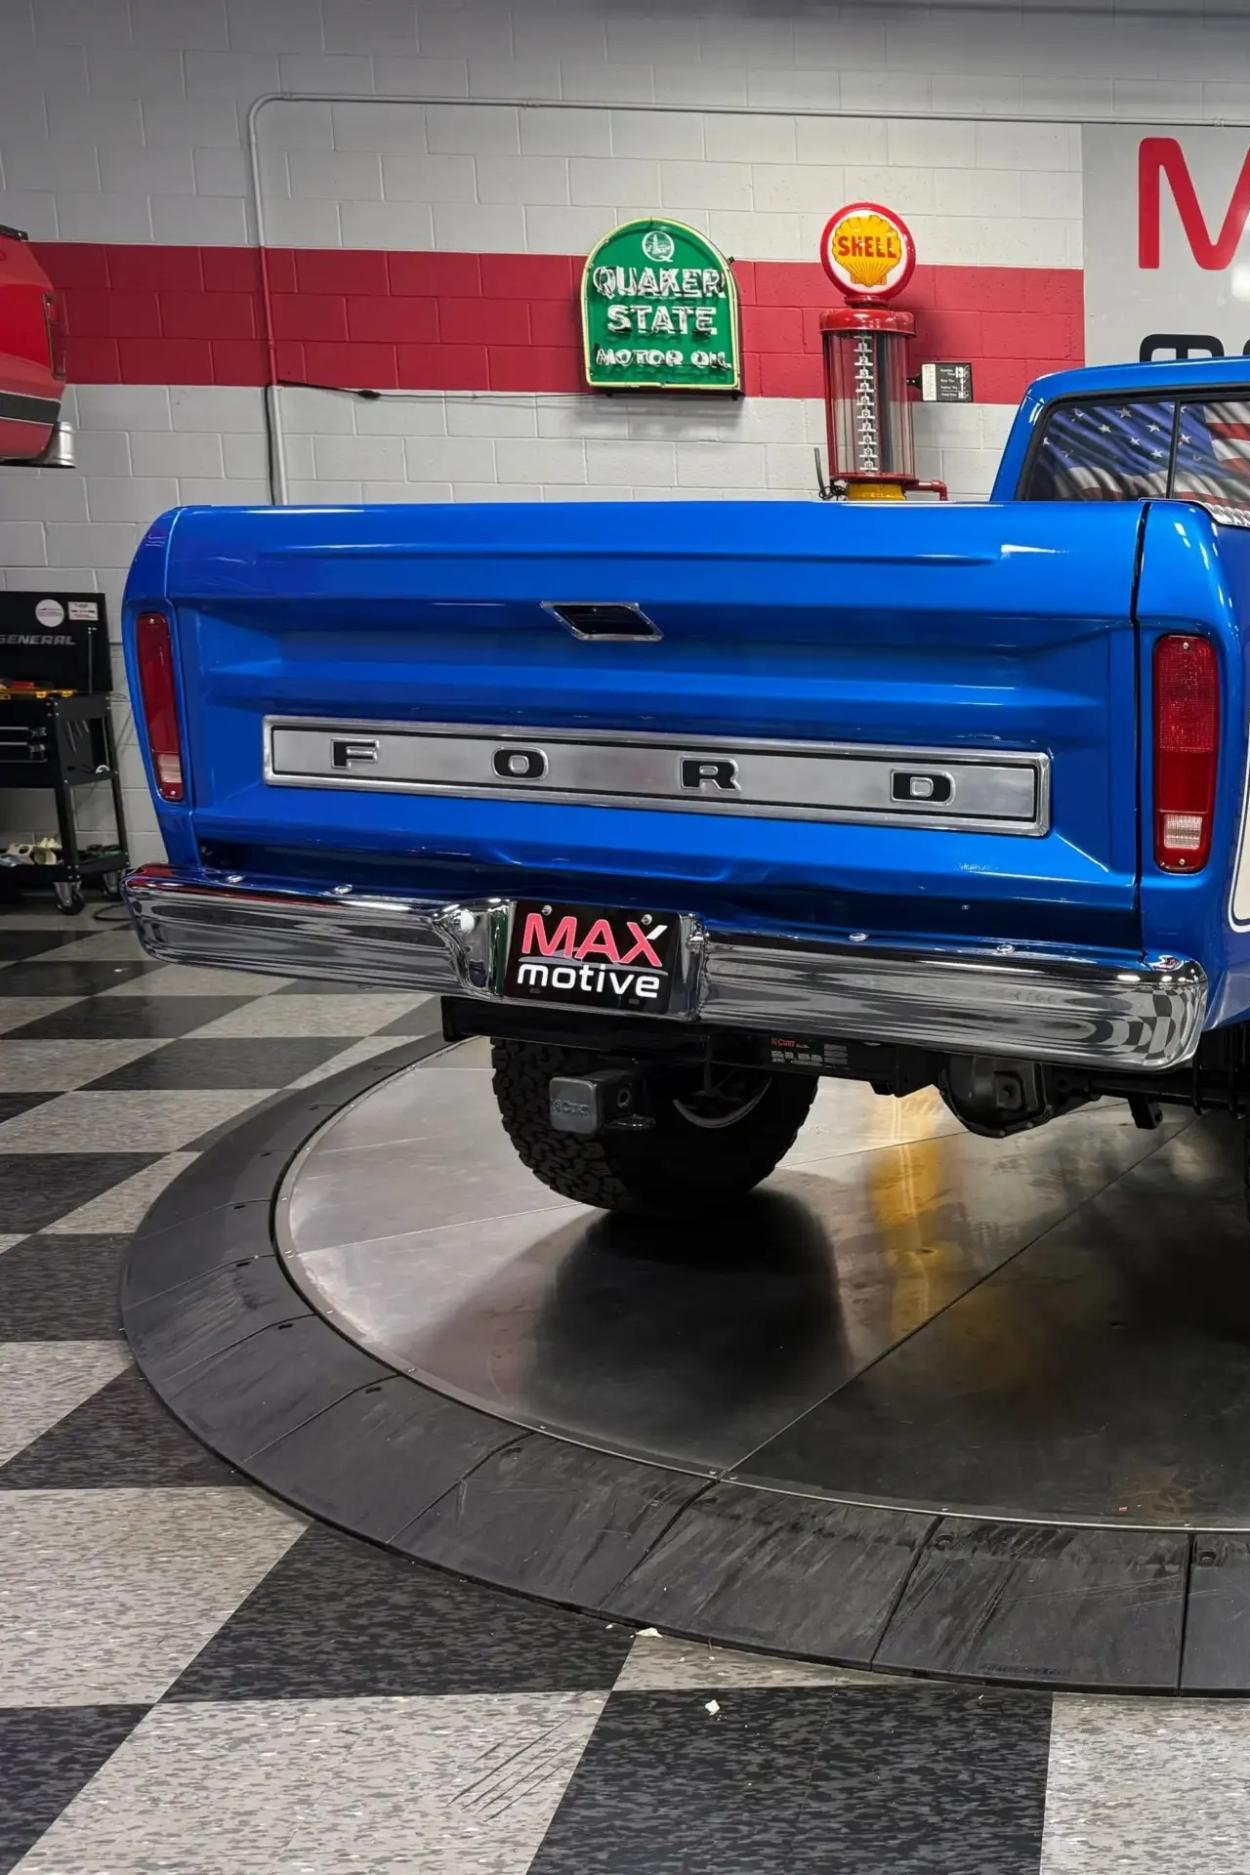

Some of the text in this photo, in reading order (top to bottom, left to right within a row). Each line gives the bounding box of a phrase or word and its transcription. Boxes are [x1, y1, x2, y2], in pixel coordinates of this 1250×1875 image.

[838, 234, 898, 259] SHELL
[593, 266, 726, 298] QUAKER
[607, 305, 718, 335] STATE
[596, 347, 685, 367] MOTOR
[329, 737, 956, 806] FORD
[521, 912, 668, 968] MAX
[517, 963, 660, 999] motive
